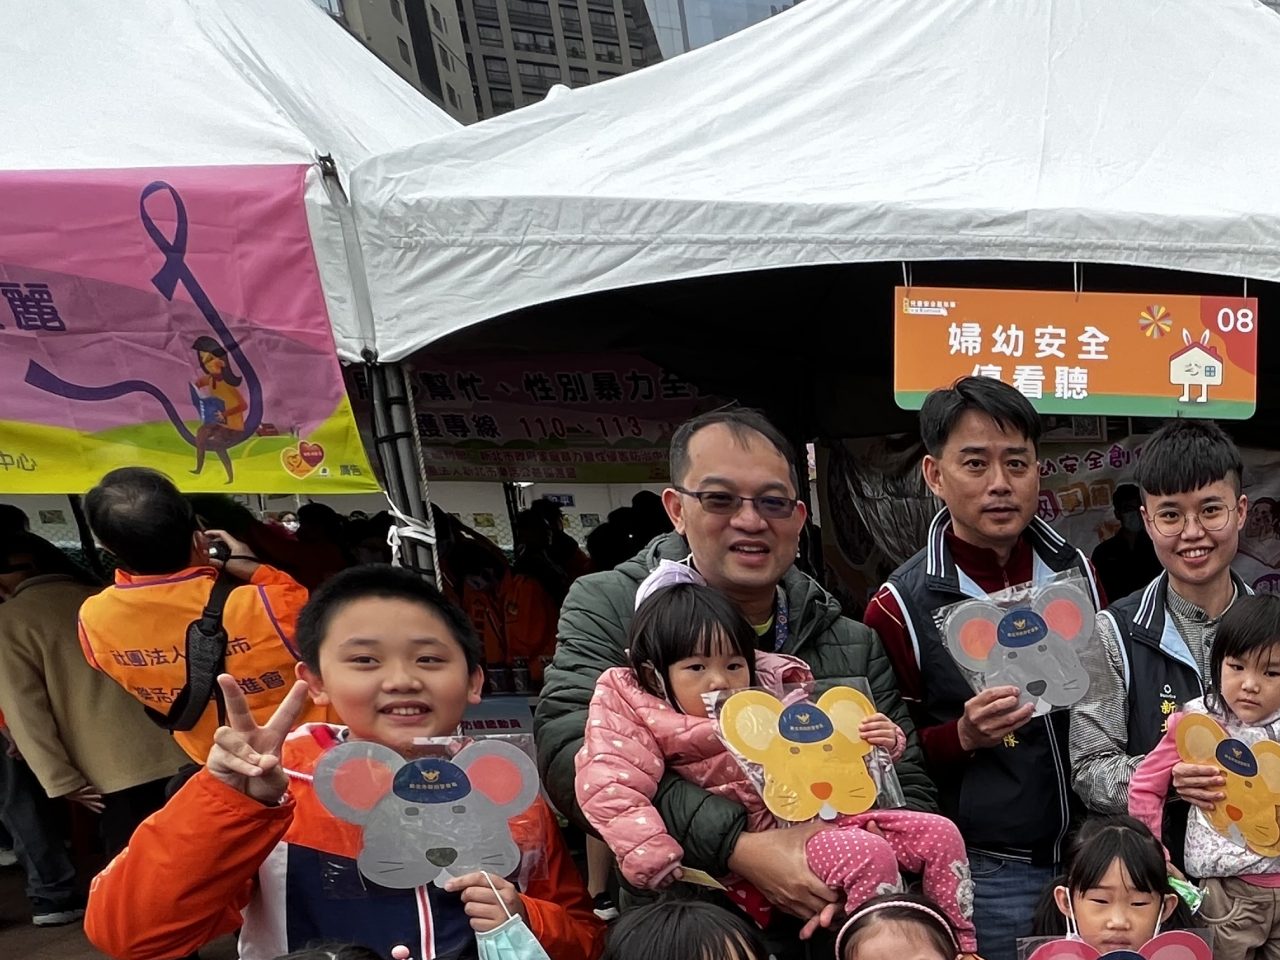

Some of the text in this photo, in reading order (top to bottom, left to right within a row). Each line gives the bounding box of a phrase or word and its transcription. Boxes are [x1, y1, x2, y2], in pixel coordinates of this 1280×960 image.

[1217, 308, 1254, 332] 08
[948, 322, 1110, 360] 婦幼安全
